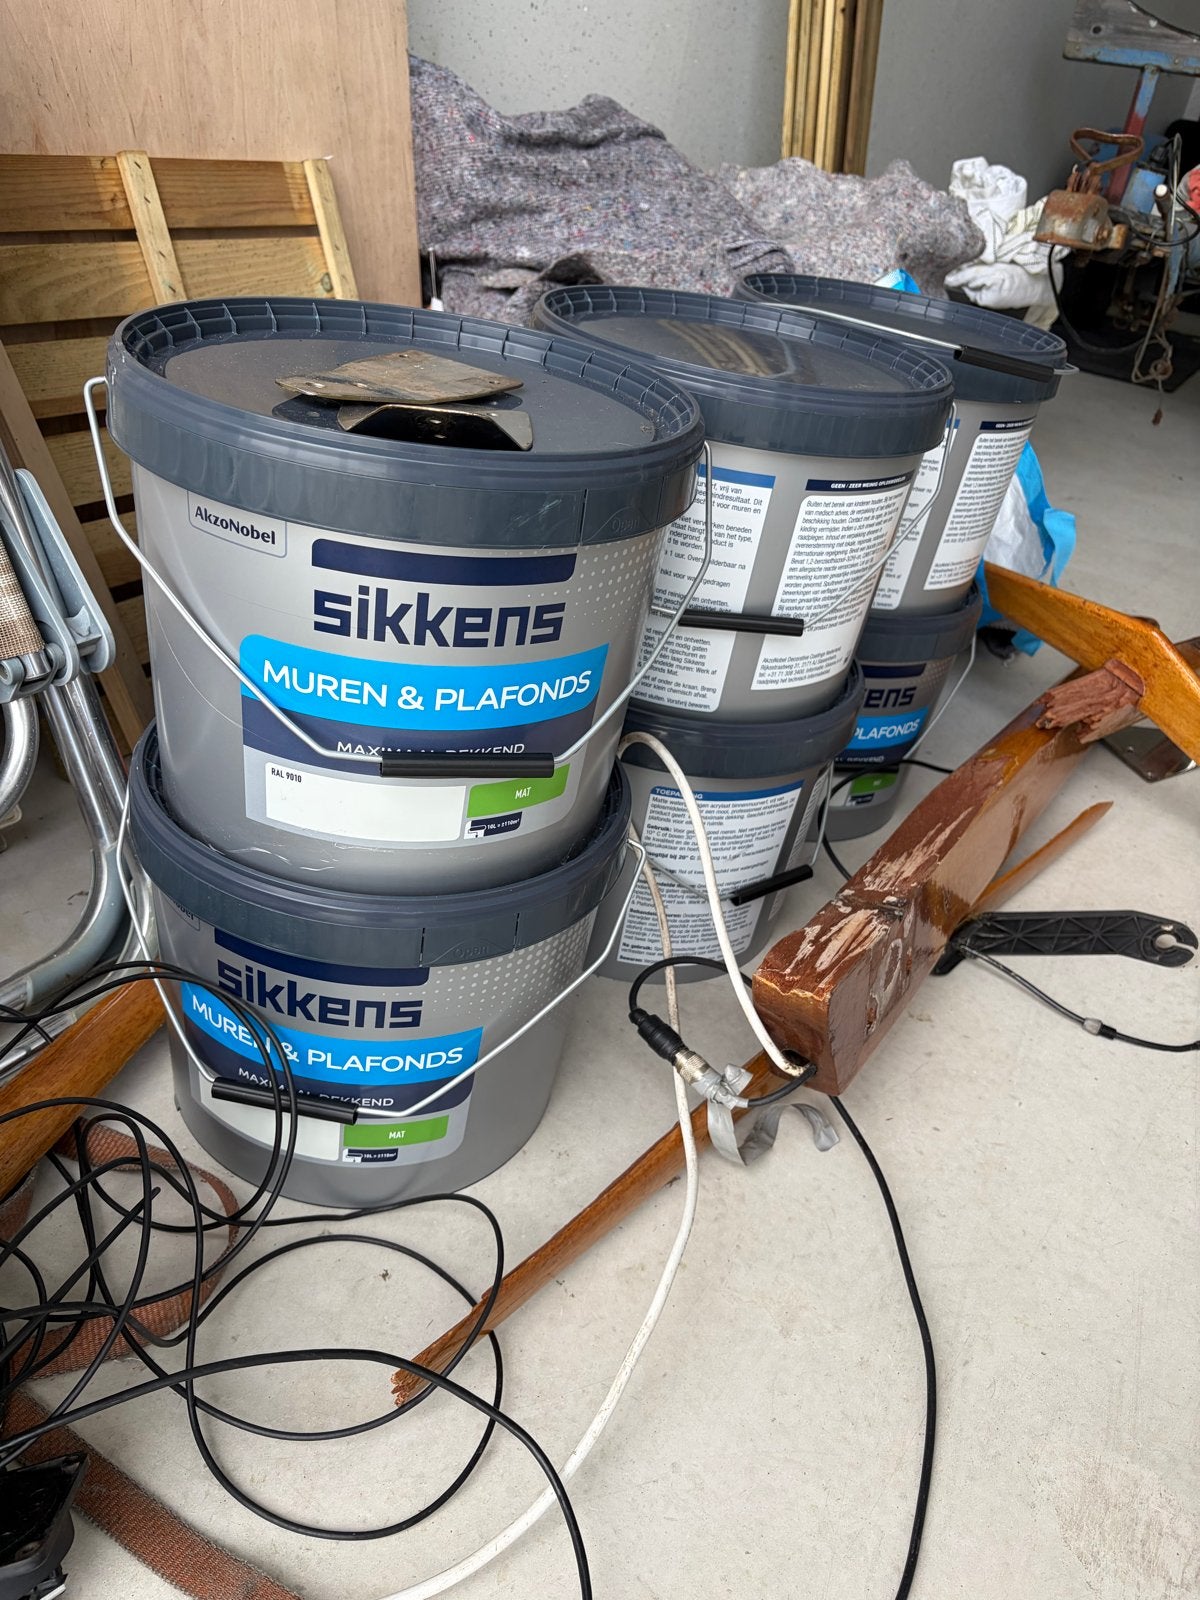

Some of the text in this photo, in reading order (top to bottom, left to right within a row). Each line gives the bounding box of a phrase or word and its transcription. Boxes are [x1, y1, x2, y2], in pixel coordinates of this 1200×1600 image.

[195, 505, 276, 545] AkzoNobel
[313, 584, 566, 648] sikkens
[263, 660, 592, 712] MUREN & PLAFONDS
[271, 767, 302, 783] RAL 9010
[514, 786, 532, 800] MAT
[217, 958, 423, 1029] sikkens
[307, 1046, 464, 1073] PLAFONDS
[388, 1130, 406, 1140] MAT
